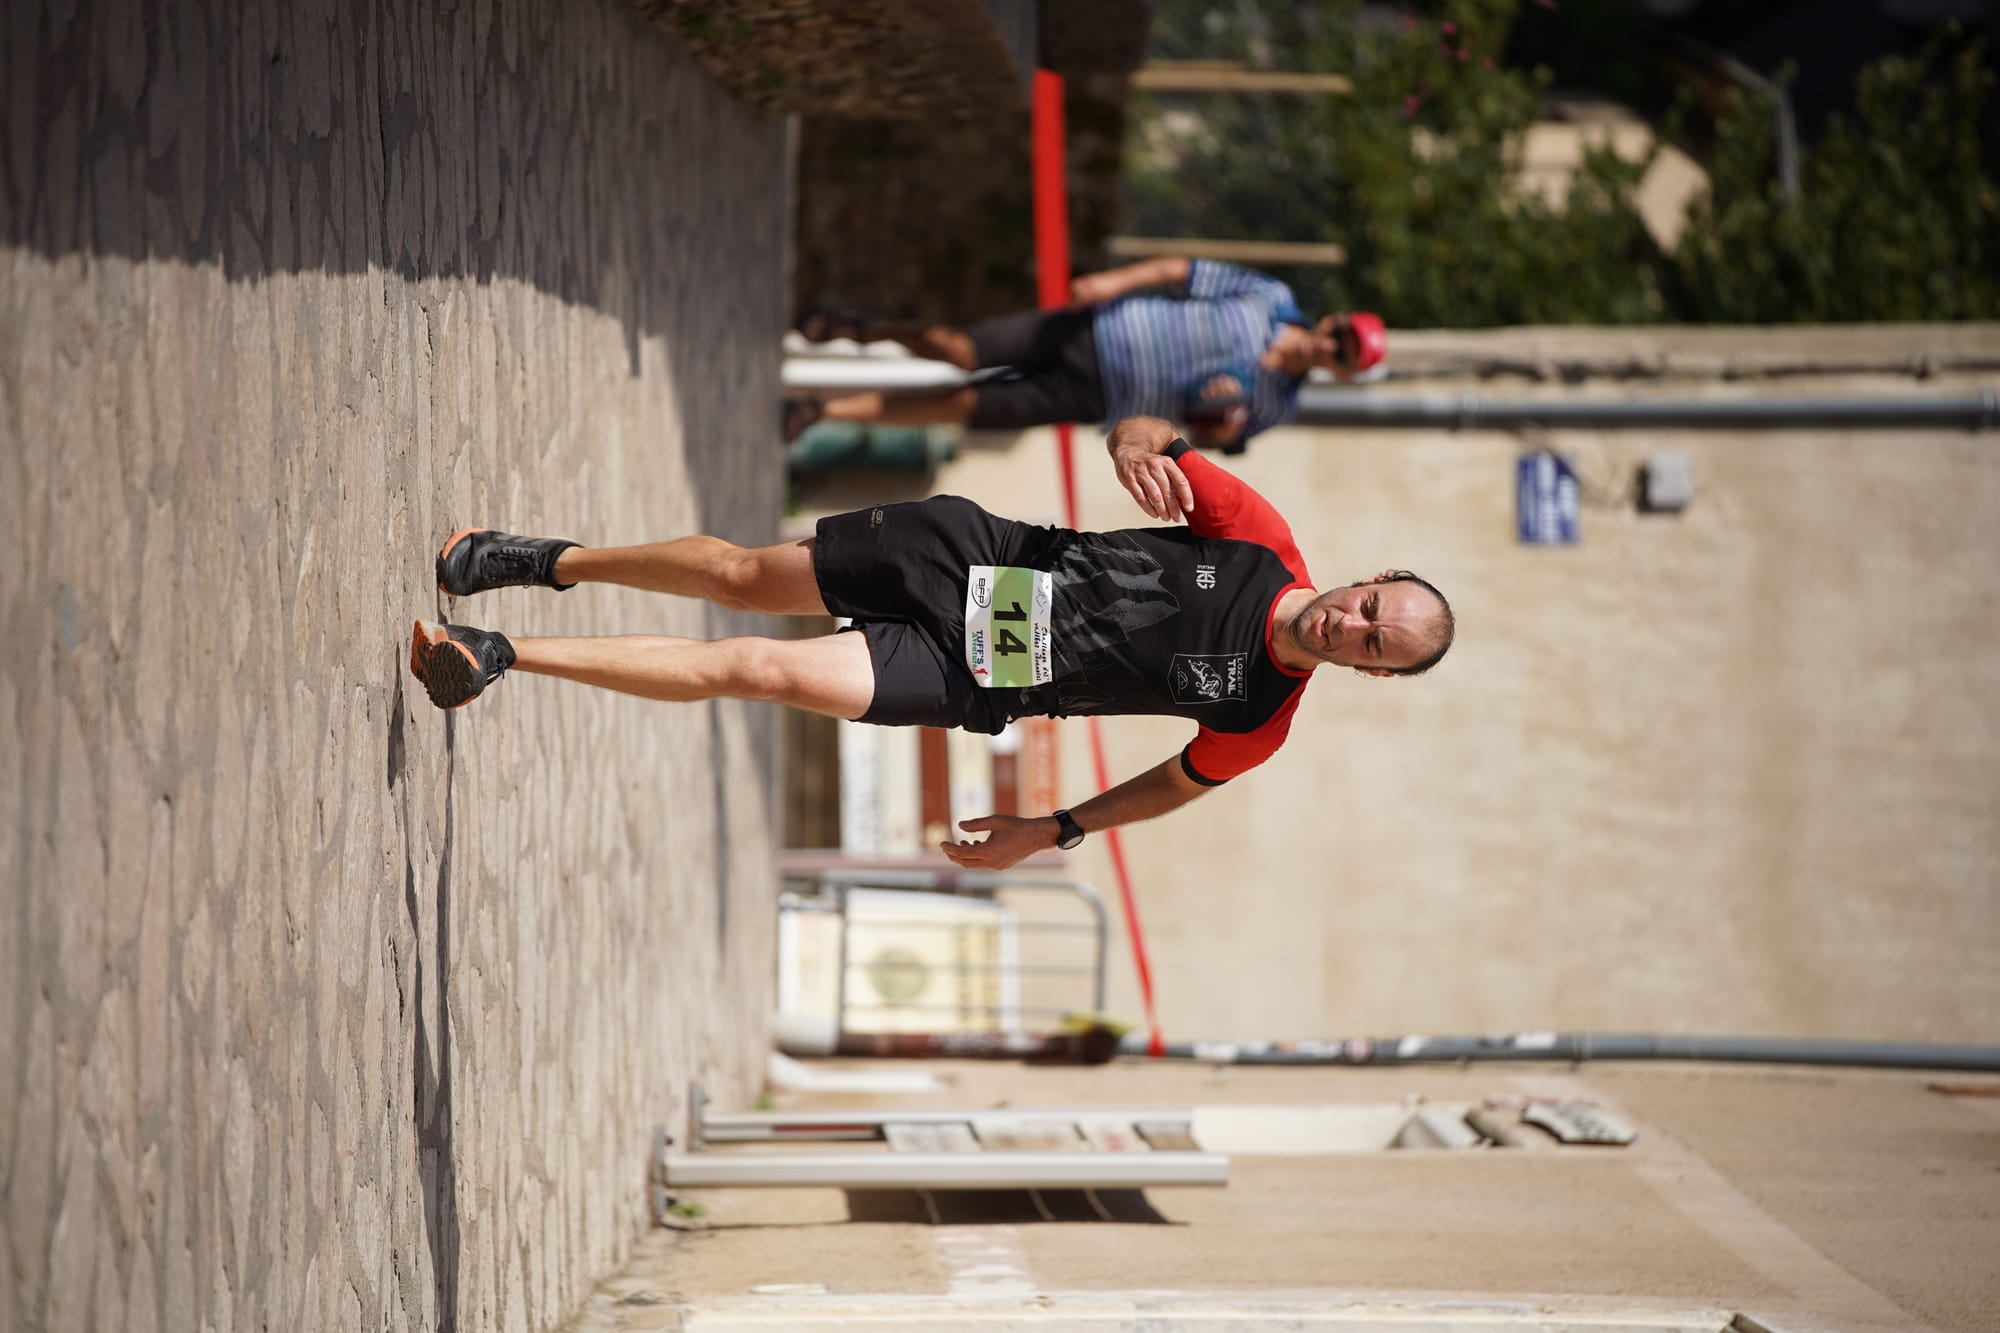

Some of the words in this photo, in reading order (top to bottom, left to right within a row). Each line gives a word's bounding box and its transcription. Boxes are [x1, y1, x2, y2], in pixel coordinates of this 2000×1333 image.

[978, 577, 986, 604] BFP
[993, 601, 1027, 656] 14
[1040, 626, 1049, 663] Challenge
[971, 632, 979, 668] Aventure
[976, 629, 984, 665] TUFF'S
[1228, 658, 1236, 695] TRAIL
